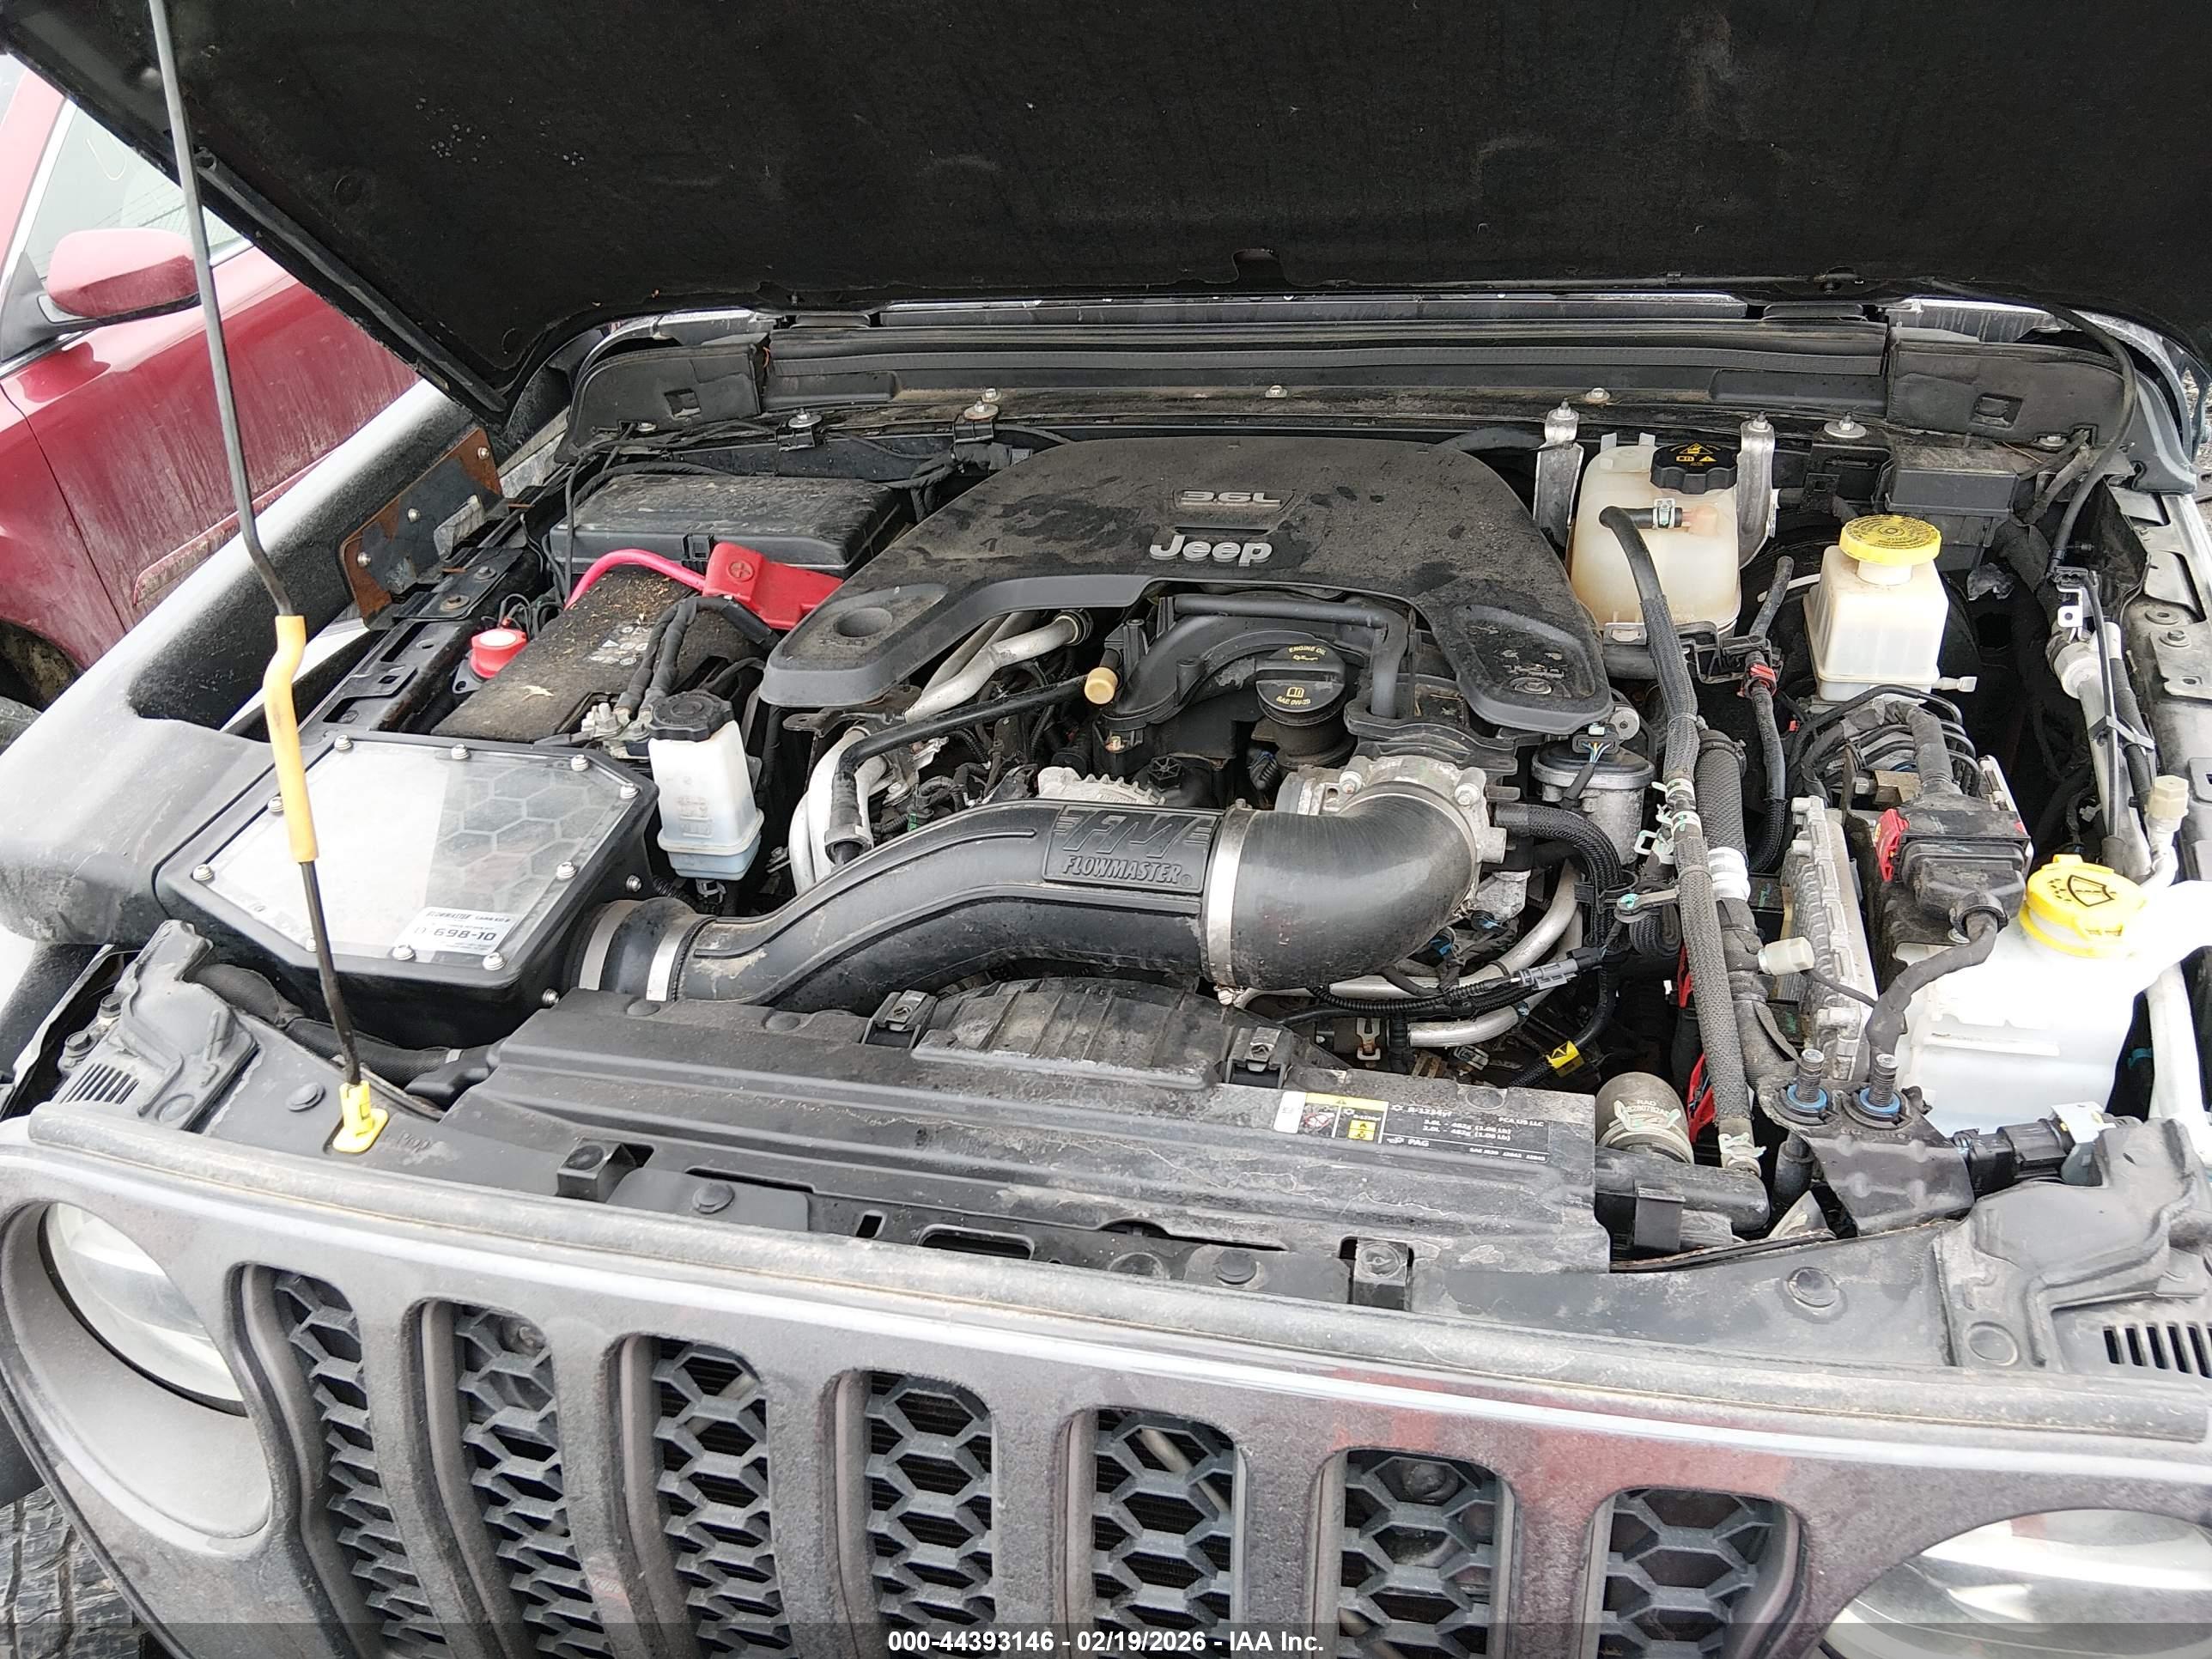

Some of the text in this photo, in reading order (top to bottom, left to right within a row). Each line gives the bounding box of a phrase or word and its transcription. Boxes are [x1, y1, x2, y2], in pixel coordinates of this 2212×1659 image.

[1180, 490, 1281, 507] 3.6L
[1149, 534, 1273, 567] Jeep
[1316, 647, 1327, 656] OIL
[1275, 696, 1289, 704] SAE
[1062, 854, 1182, 884] FLOWMASTER
